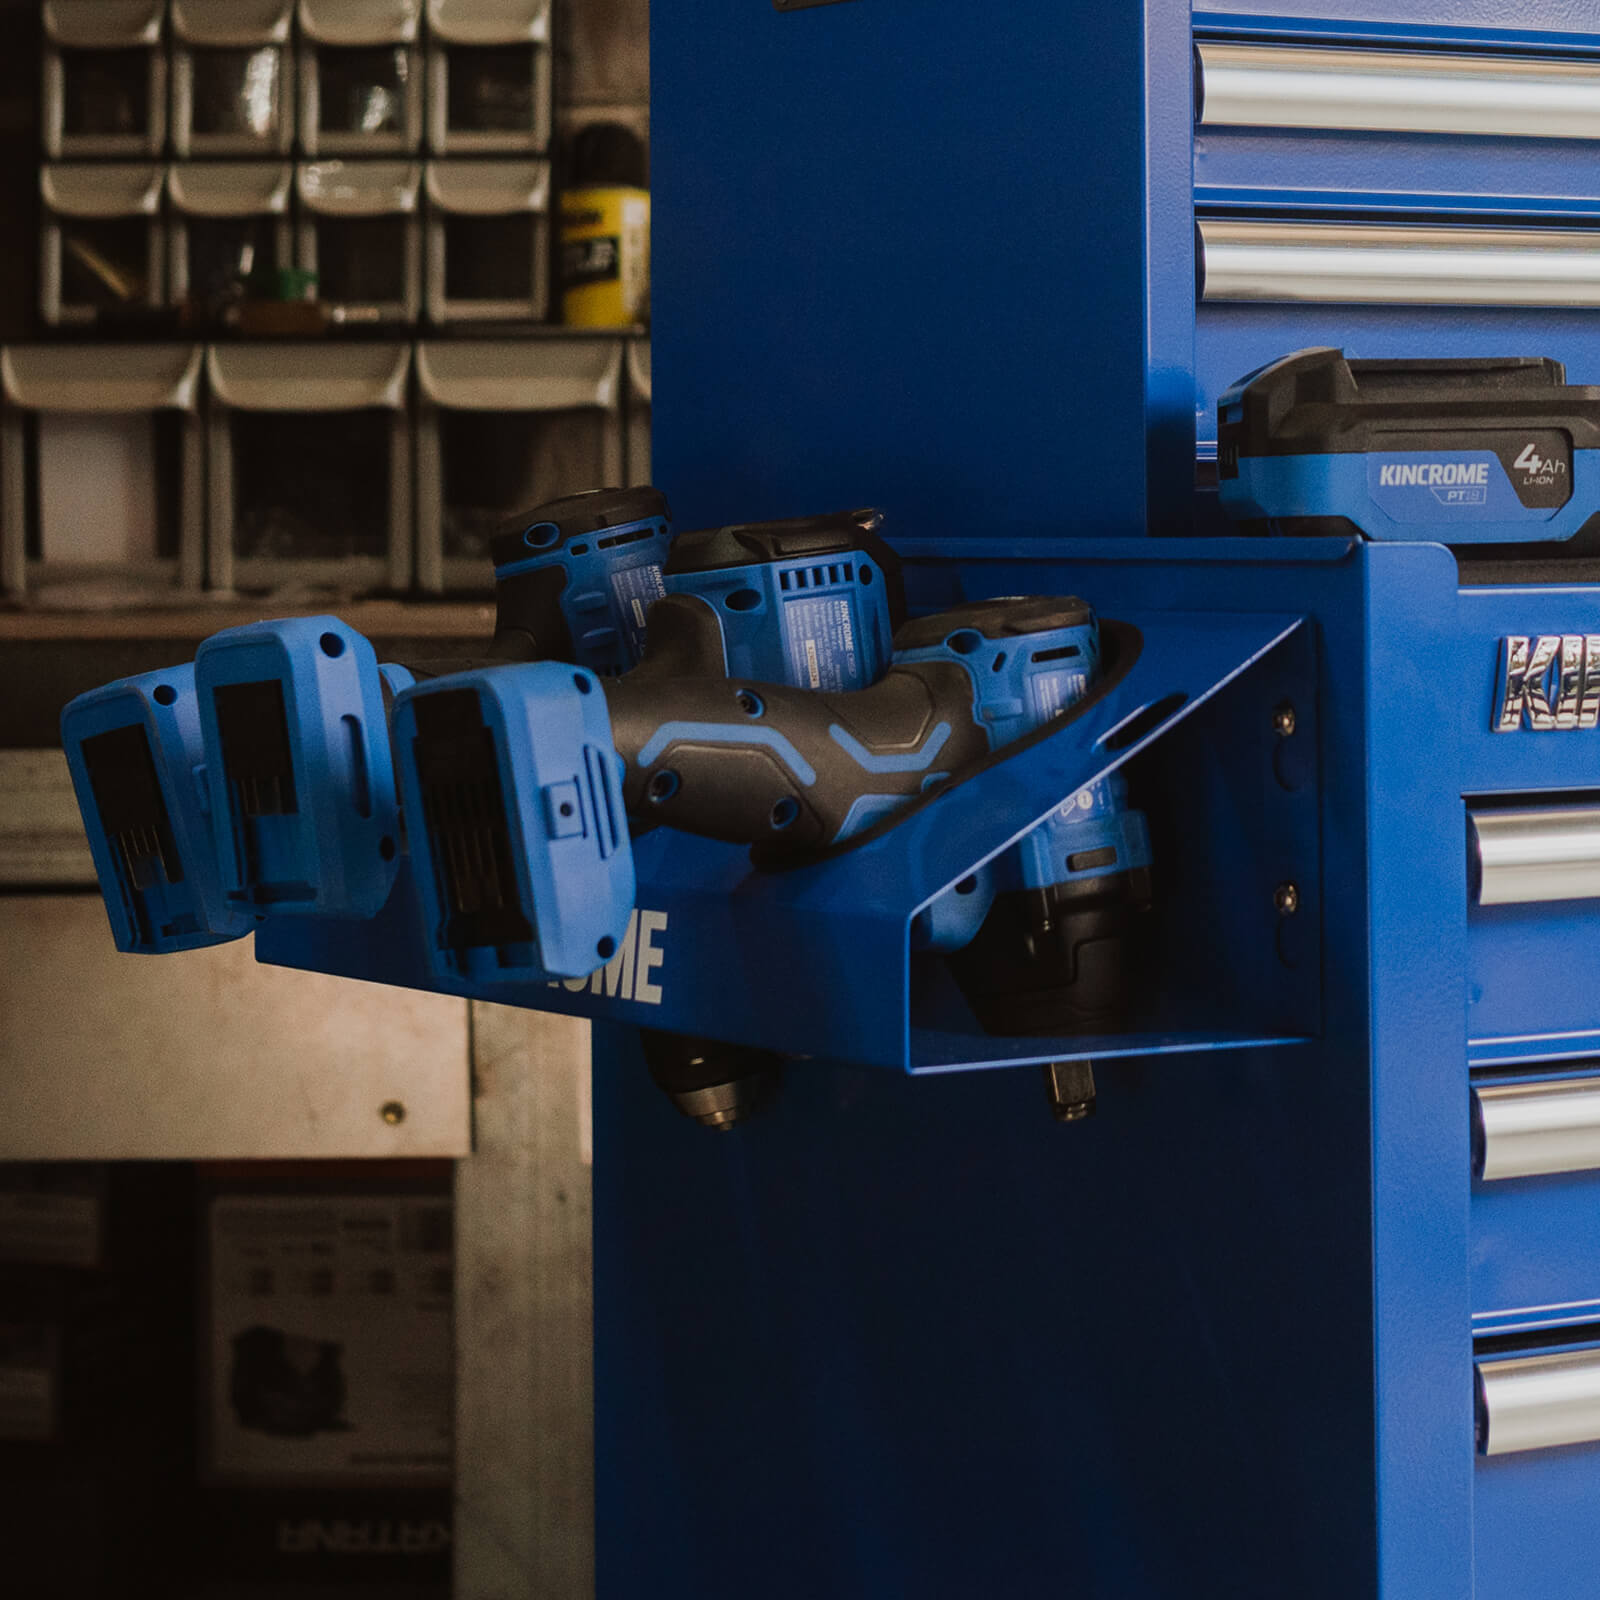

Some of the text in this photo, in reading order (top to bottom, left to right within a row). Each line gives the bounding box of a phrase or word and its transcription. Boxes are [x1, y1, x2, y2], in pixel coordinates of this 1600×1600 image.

[1513, 443, 1565, 475] 4Ah
[1380, 463, 1490, 486] KINCROME
[1523, 476, 1553, 485] LI-ION
[840, 600, 854, 651] KINCROME
